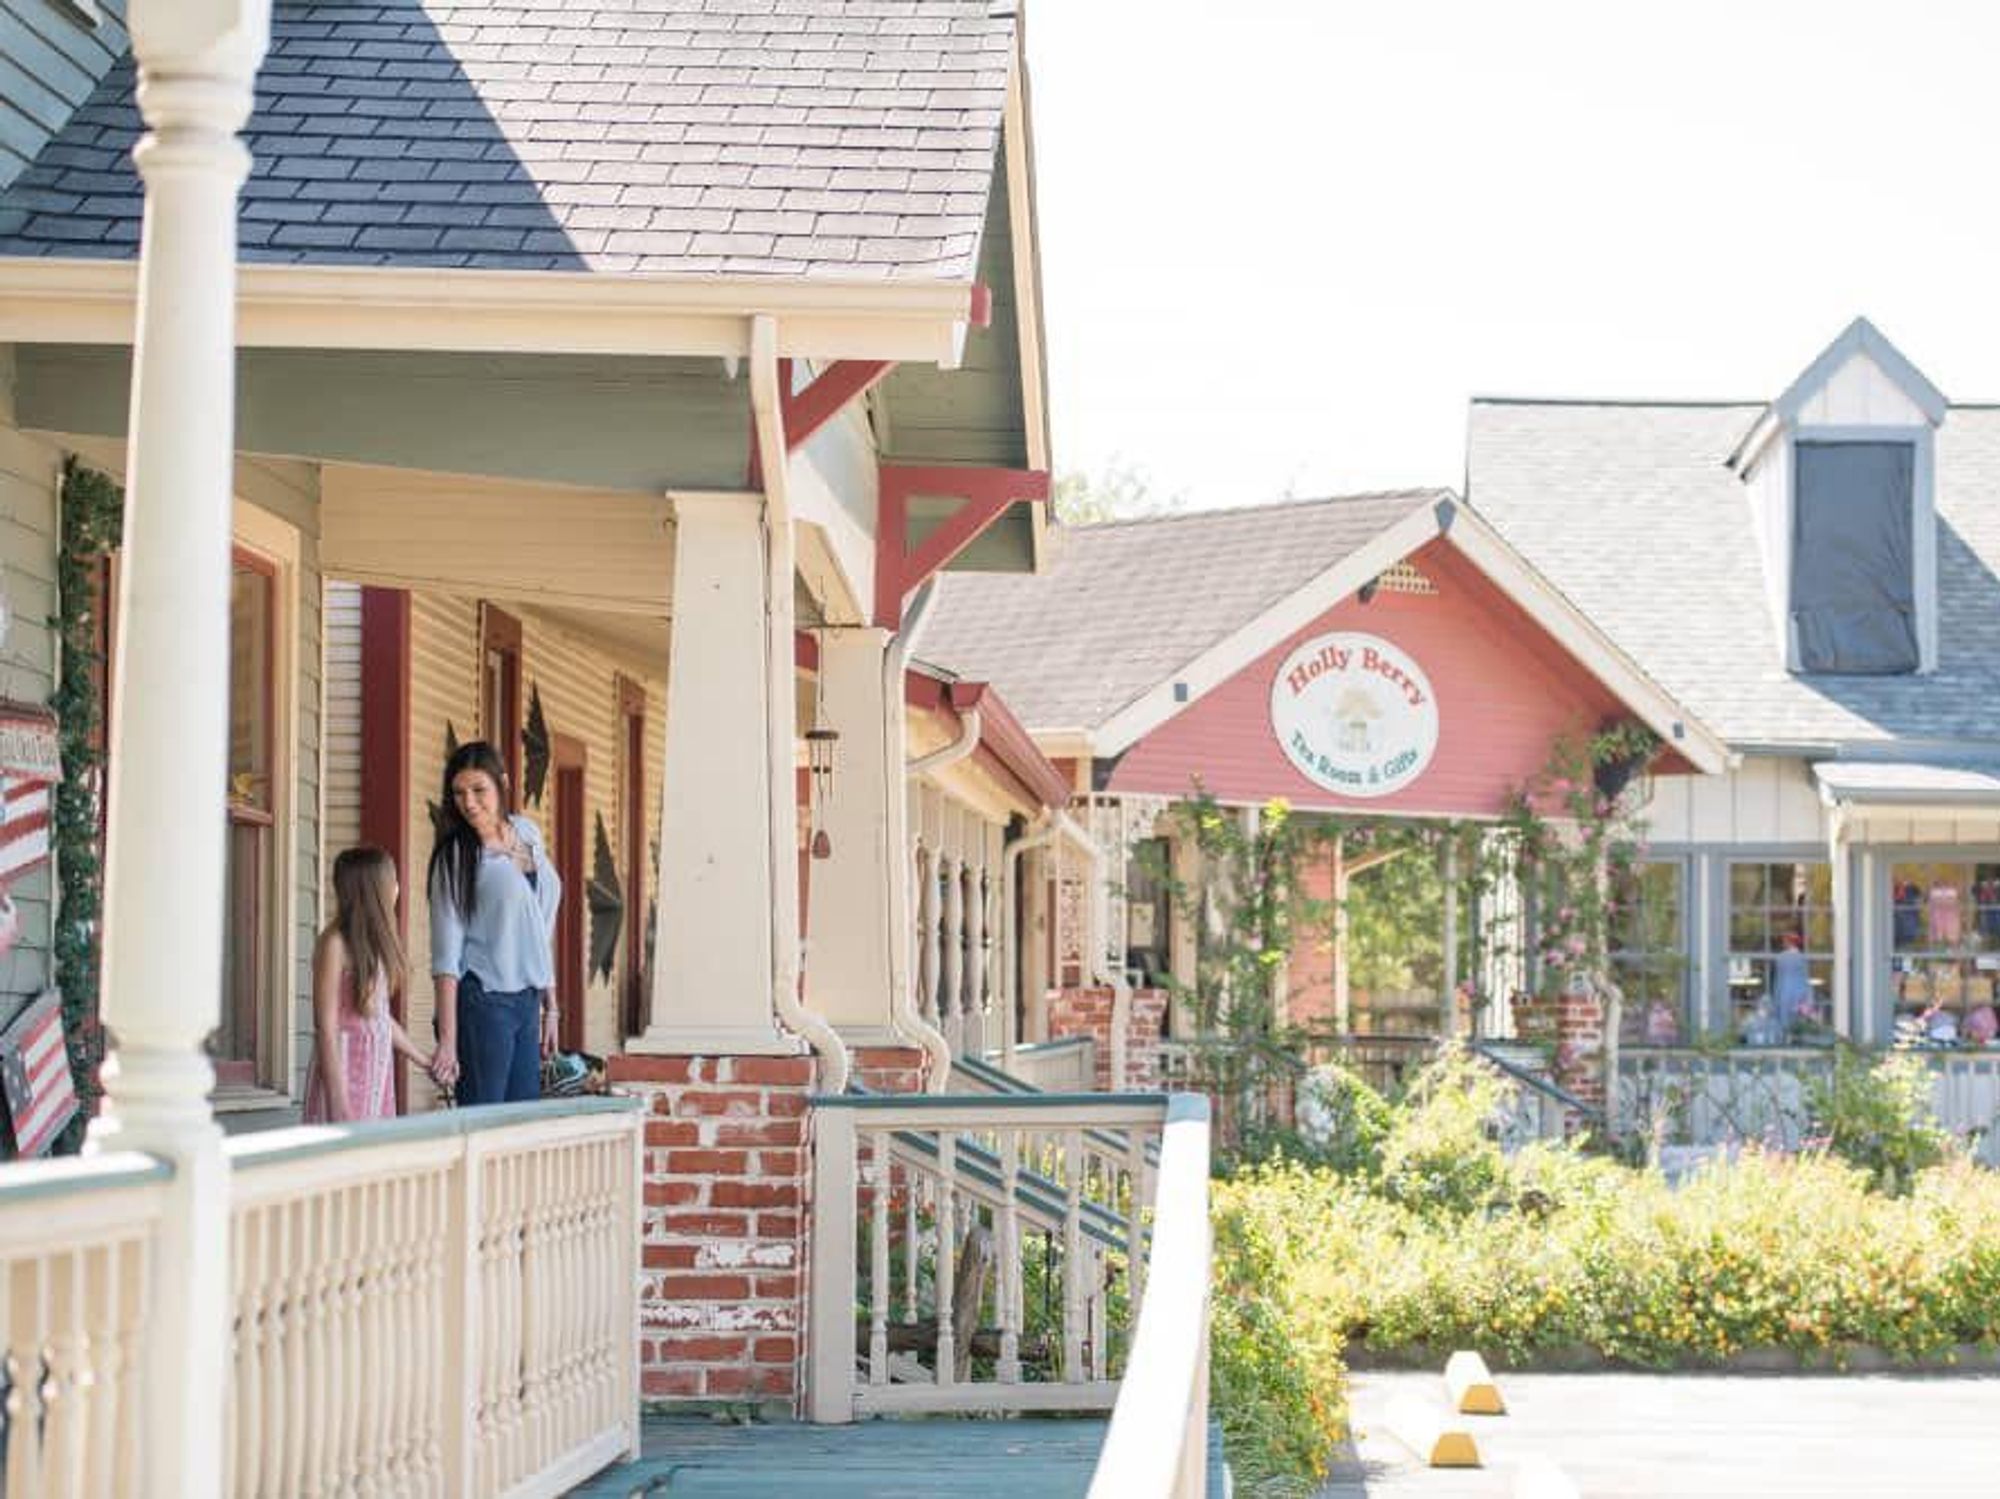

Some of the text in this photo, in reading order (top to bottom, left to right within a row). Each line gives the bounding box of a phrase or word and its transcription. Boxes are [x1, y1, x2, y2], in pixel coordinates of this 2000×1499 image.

[1287, 643, 1426, 705] Holly Berry
[1291, 729, 1418, 784] Tea Room & Gifts
